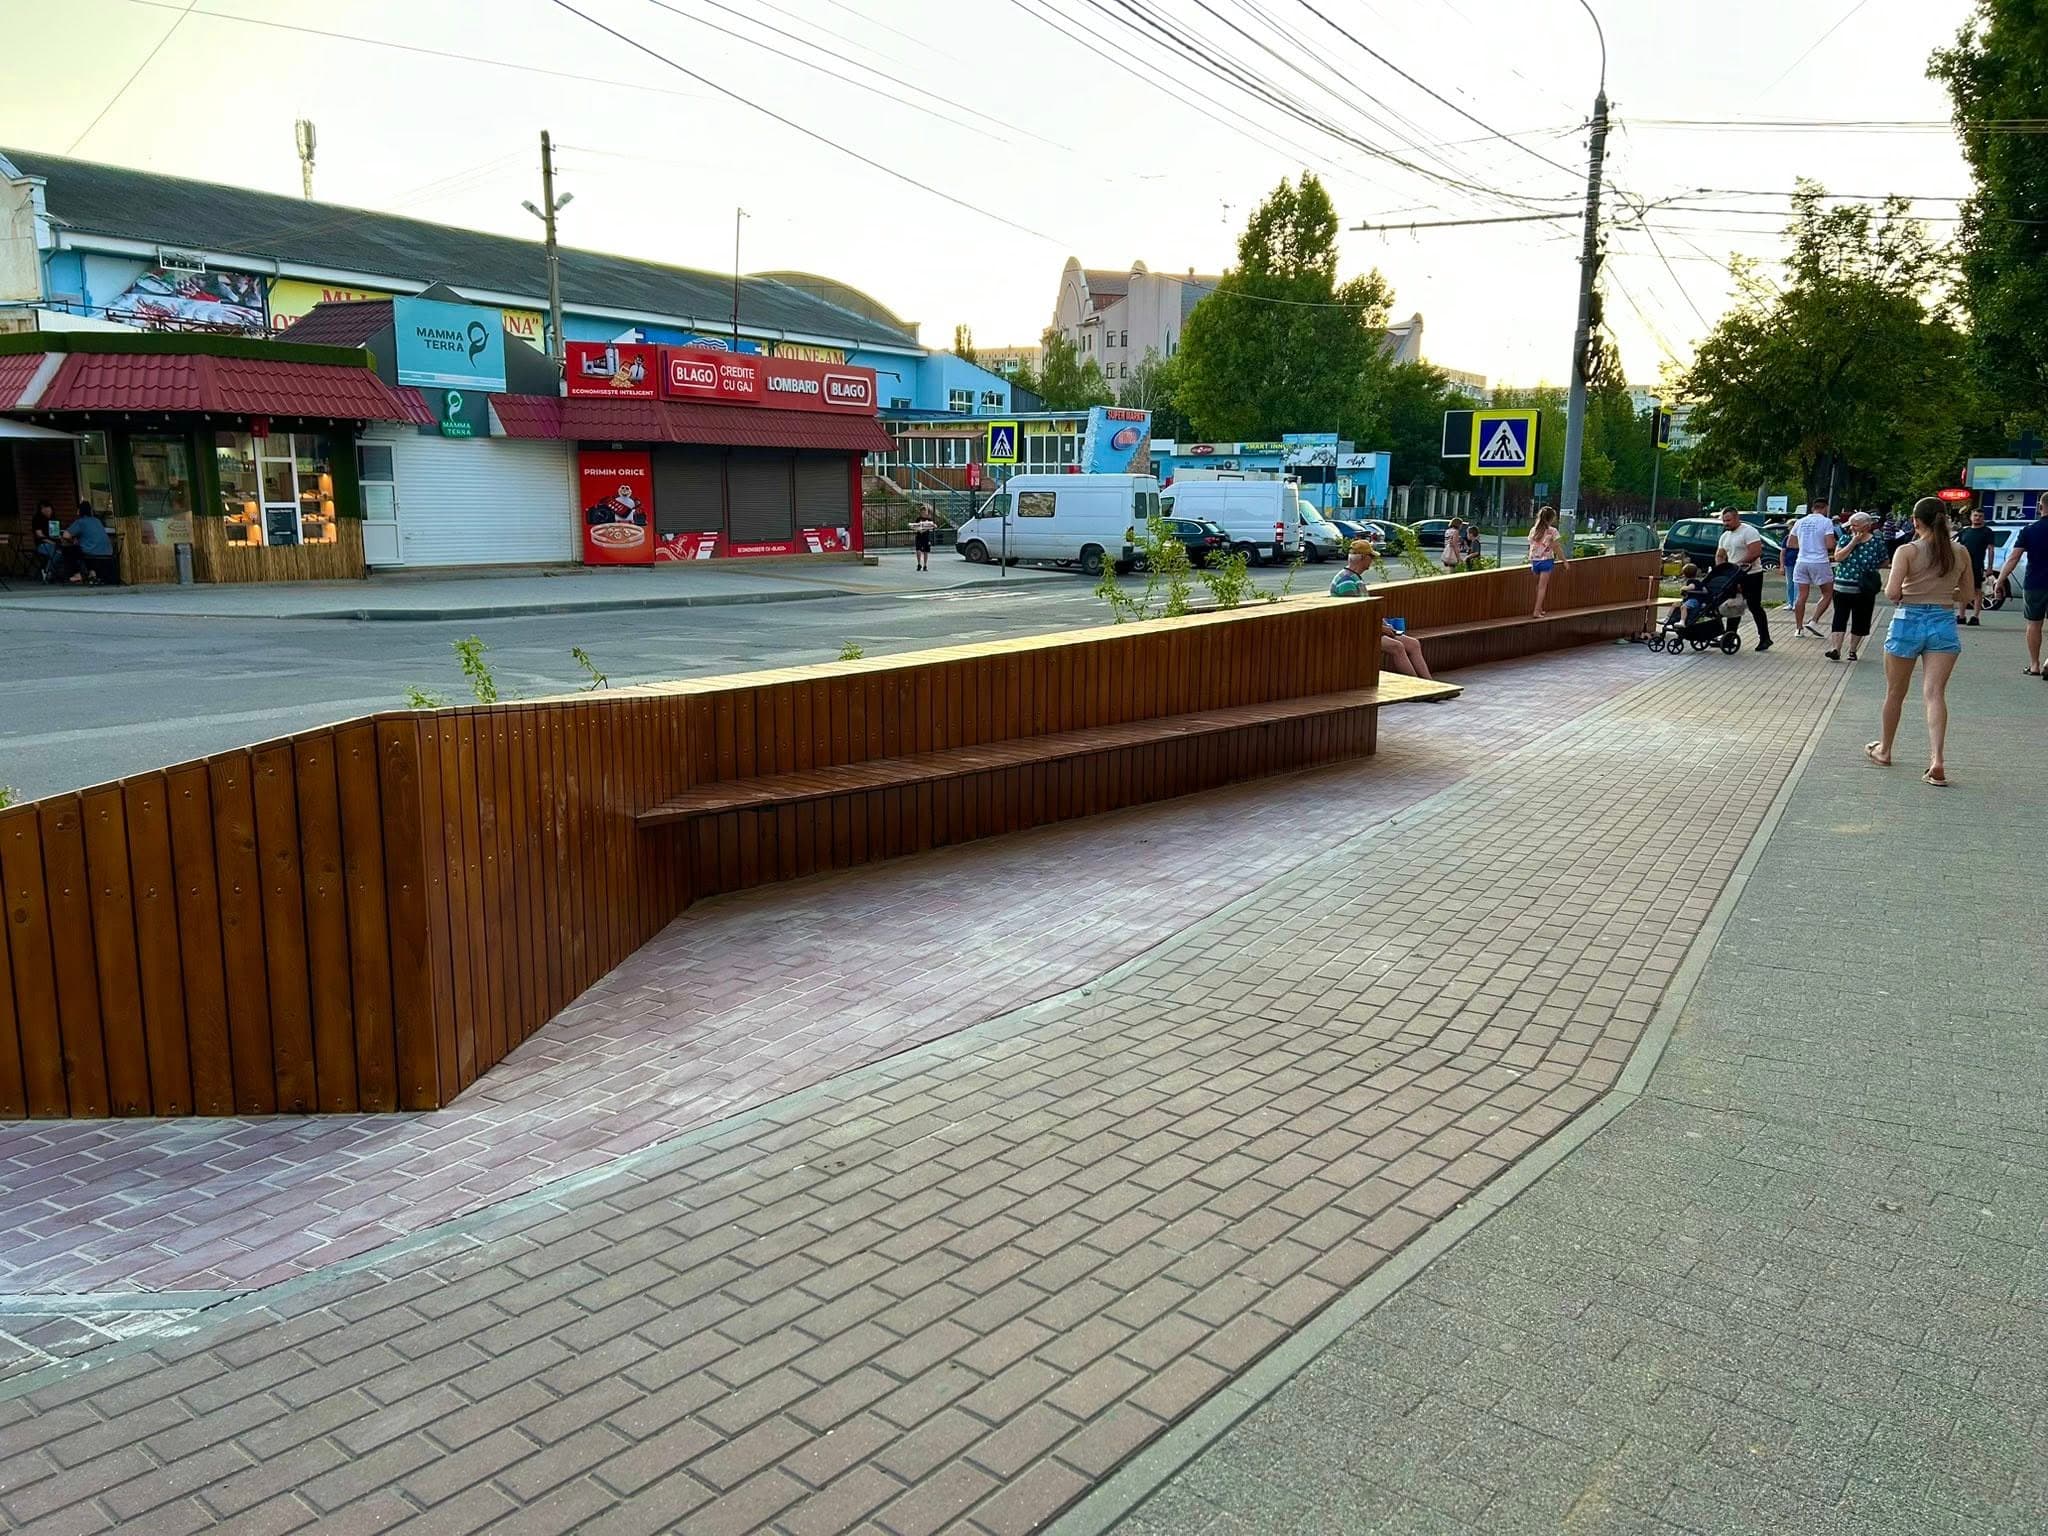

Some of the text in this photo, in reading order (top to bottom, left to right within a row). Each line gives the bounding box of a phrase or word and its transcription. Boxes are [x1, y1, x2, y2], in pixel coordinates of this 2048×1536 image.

[416, 326, 464, 342] MAMMA
[424, 339, 464, 352] TERRA
[676, 366, 714, 383] BLAGO
[720, 365, 755, 379] CREDITE
[723, 379, 753, 393] CU GAJ
[767, 376, 865, 398] LOMBARD BLAGO
[448, 428, 471, 436] TERRA
[584, 468, 645, 476] PRIMIM ORICE
